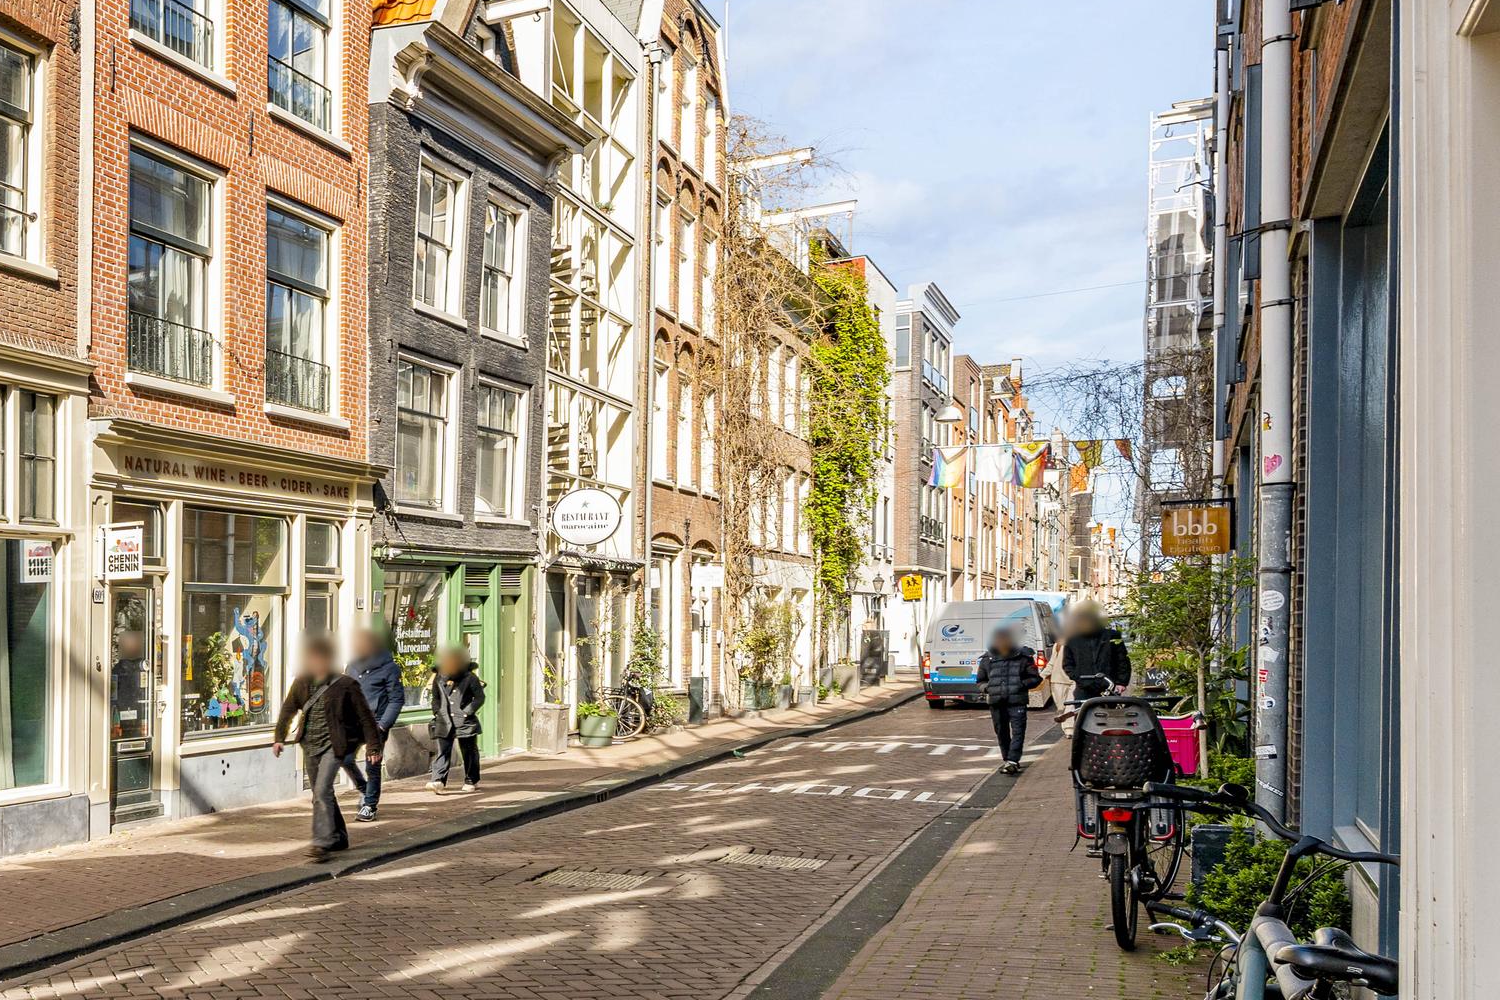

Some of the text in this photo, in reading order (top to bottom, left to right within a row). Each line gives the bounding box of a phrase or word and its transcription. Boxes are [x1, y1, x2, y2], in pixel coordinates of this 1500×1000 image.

[124, 455, 349, 499] NATURAL WINE BEER CIDER SAKE
[561, 512, 609, 522] RESTAURANT
[561, 522, 609, 530] marocaine
[1173, 510, 1218, 536] bbb
[1177, 536, 1213, 545] health
[108, 553, 139, 564] CHENIN
[108, 563, 139, 573] CHENIN
[396, 627, 431, 639] Restaurant
[397, 641, 431, 654] Marocaine
[647, 782, 961, 806] SCHOOL
